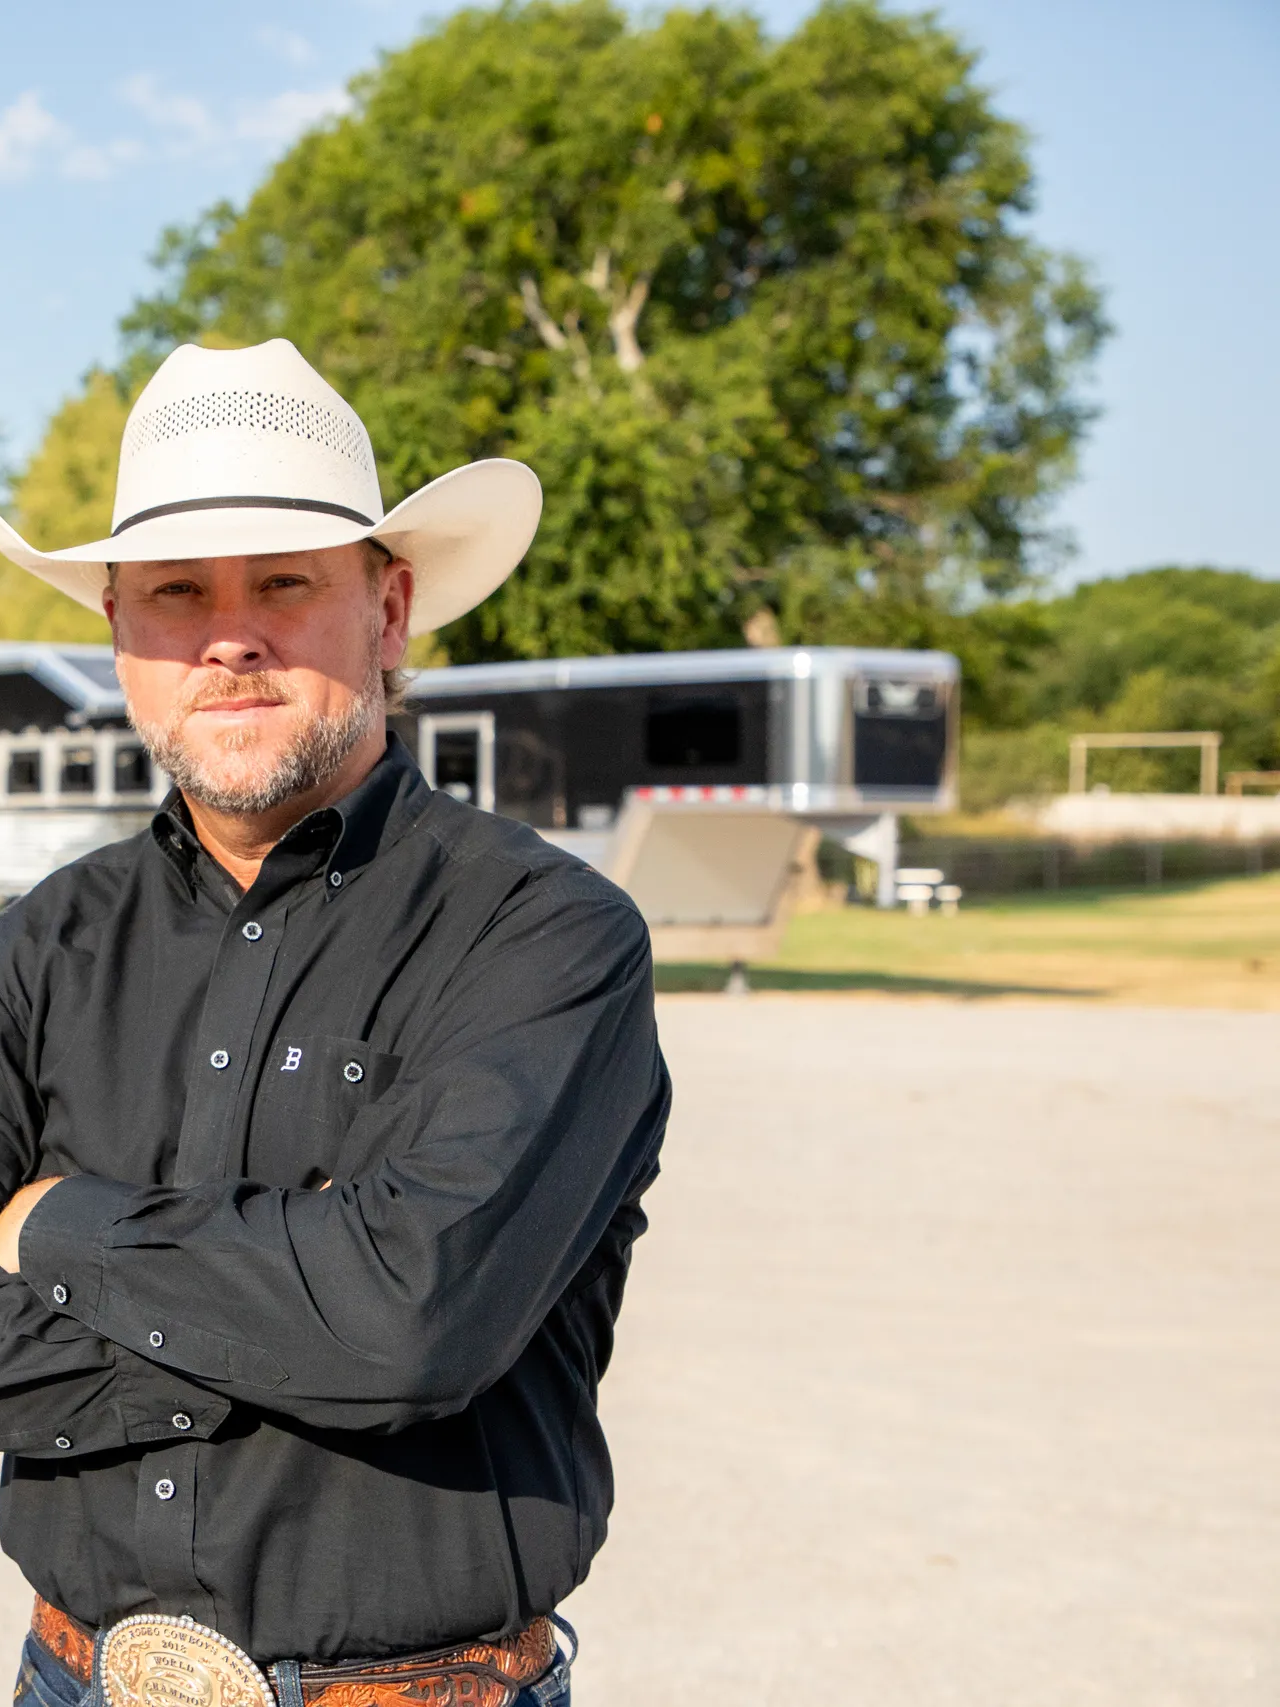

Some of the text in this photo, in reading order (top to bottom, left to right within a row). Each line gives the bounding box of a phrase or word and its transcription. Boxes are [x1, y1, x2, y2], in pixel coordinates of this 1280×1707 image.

[280, 1046, 302, 1071] B
[129, 1627, 160, 1639] RODEO
[163, 1628, 218, 1655] COWBOYS
[153, 1656, 194, 1673] WORLD
[145, 1682, 206, 1706] CHAMPION
